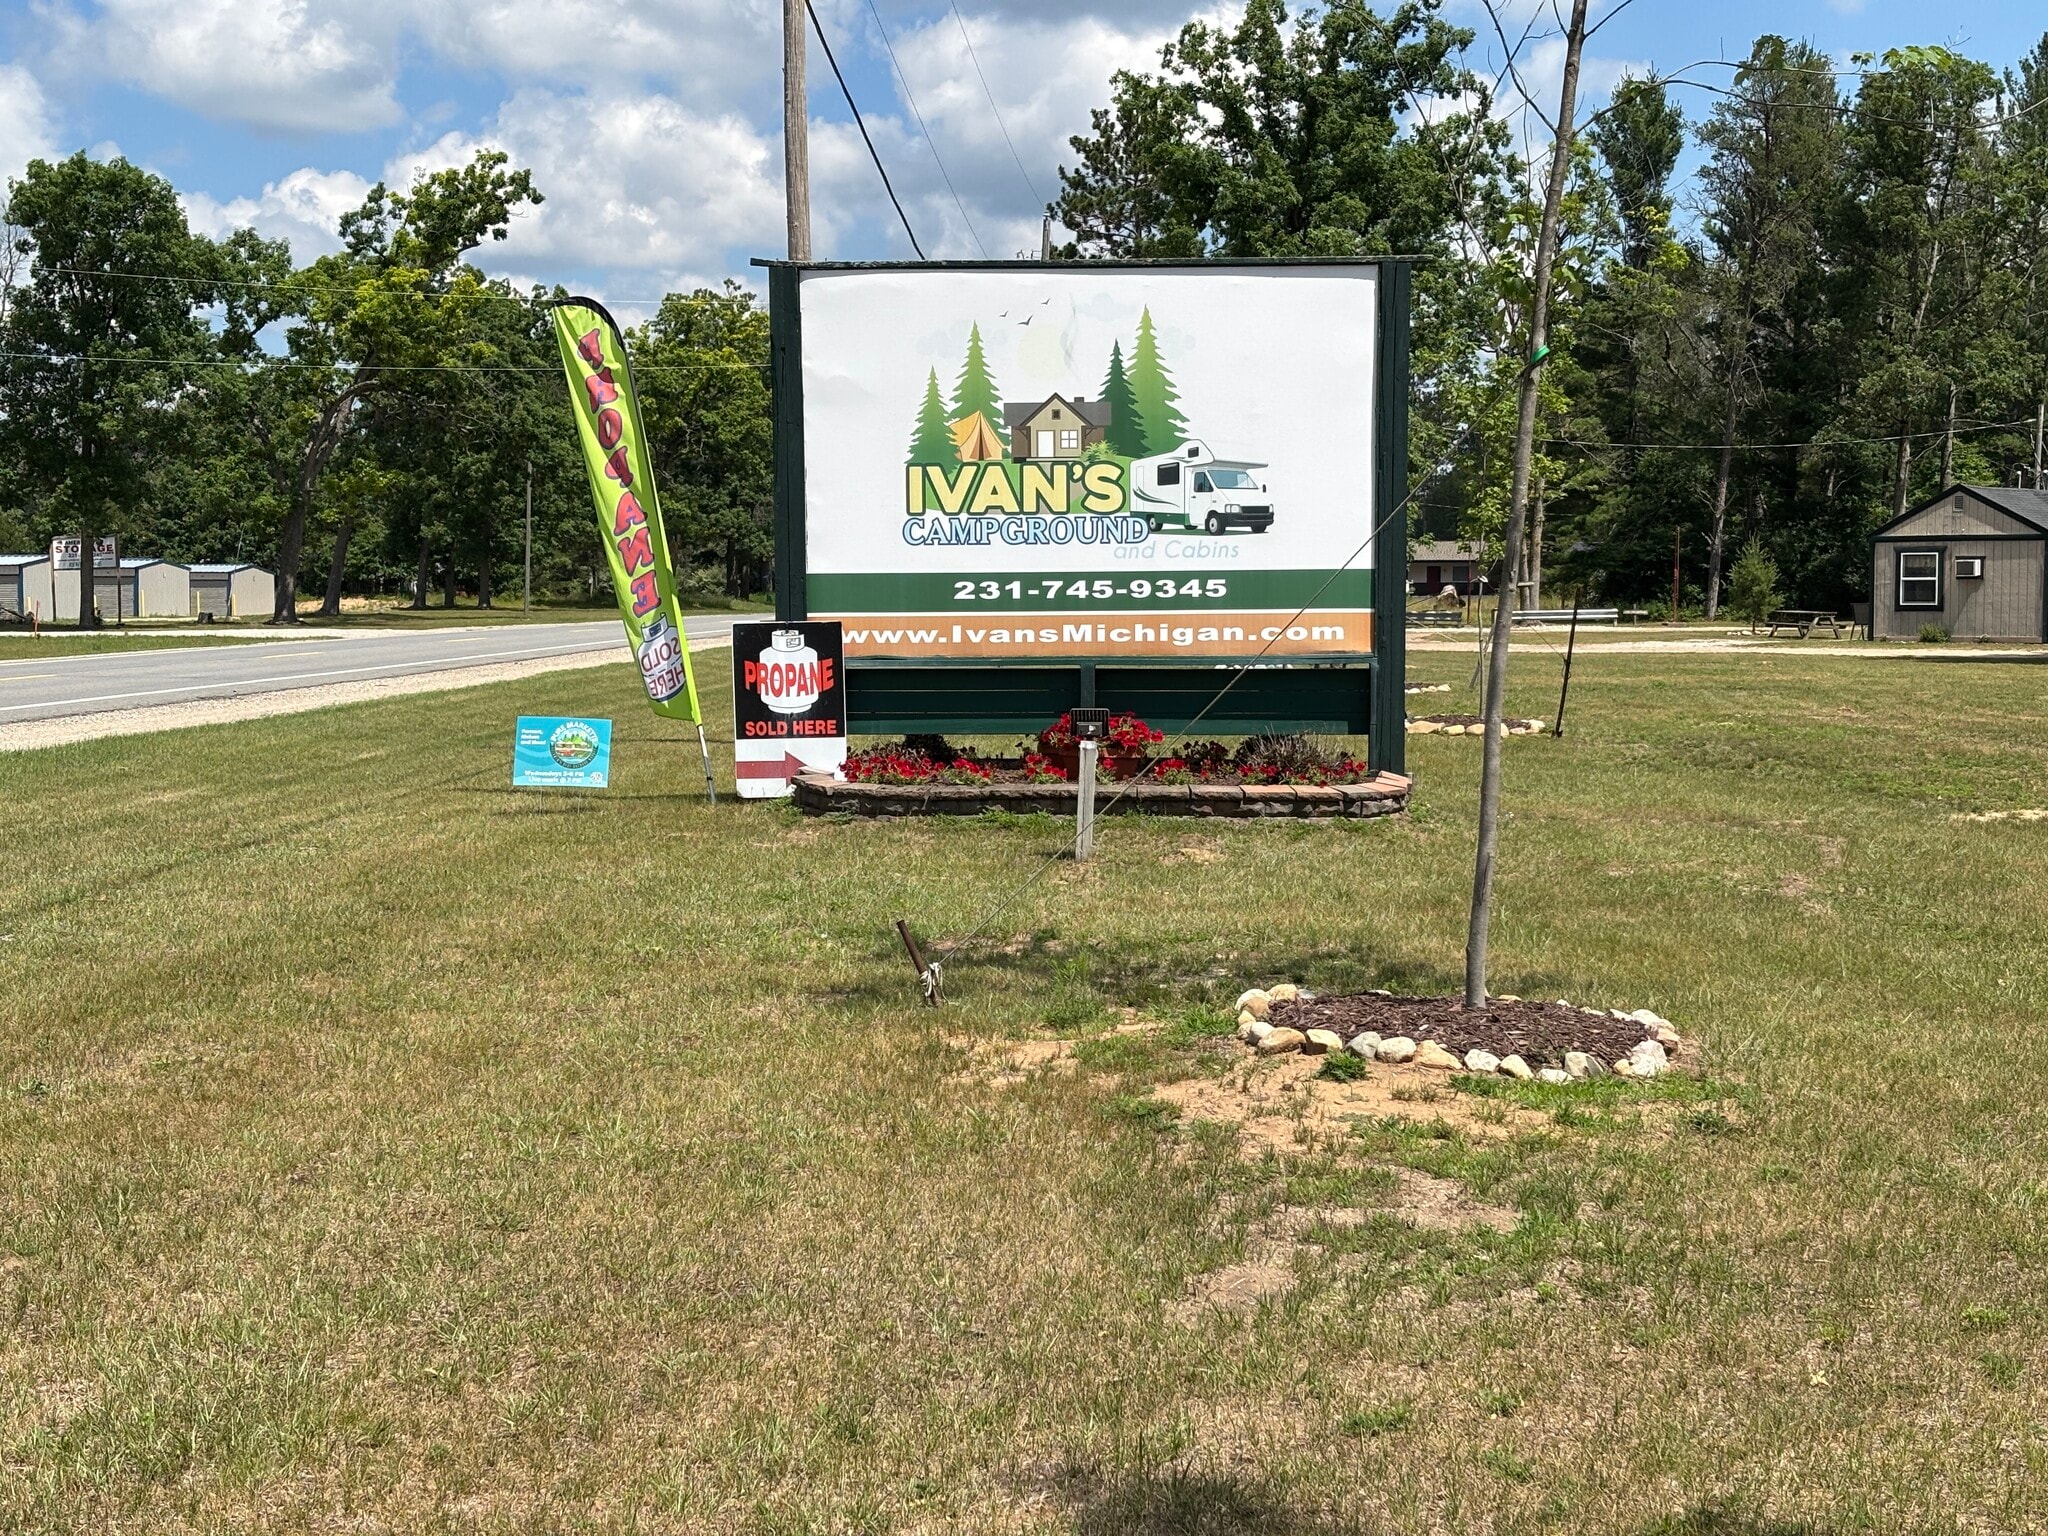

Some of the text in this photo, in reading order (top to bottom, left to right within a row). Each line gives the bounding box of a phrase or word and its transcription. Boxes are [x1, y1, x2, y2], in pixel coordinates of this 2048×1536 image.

[905, 461, 1125, 516] IVAN'S
[902, 516, 1151, 546] CAMPGROUND
[55, 544, 113, 553] STOGE
[1113, 540, 1240, 560] and Cabins
[953, 579, 1228, 601] 231-745-9345
[842, 623, 1345, 647] www.IvansMichigan.com
[744, 658, 835, 698] PROPANE
[745, 719, 838, 737] SOLD HERE
